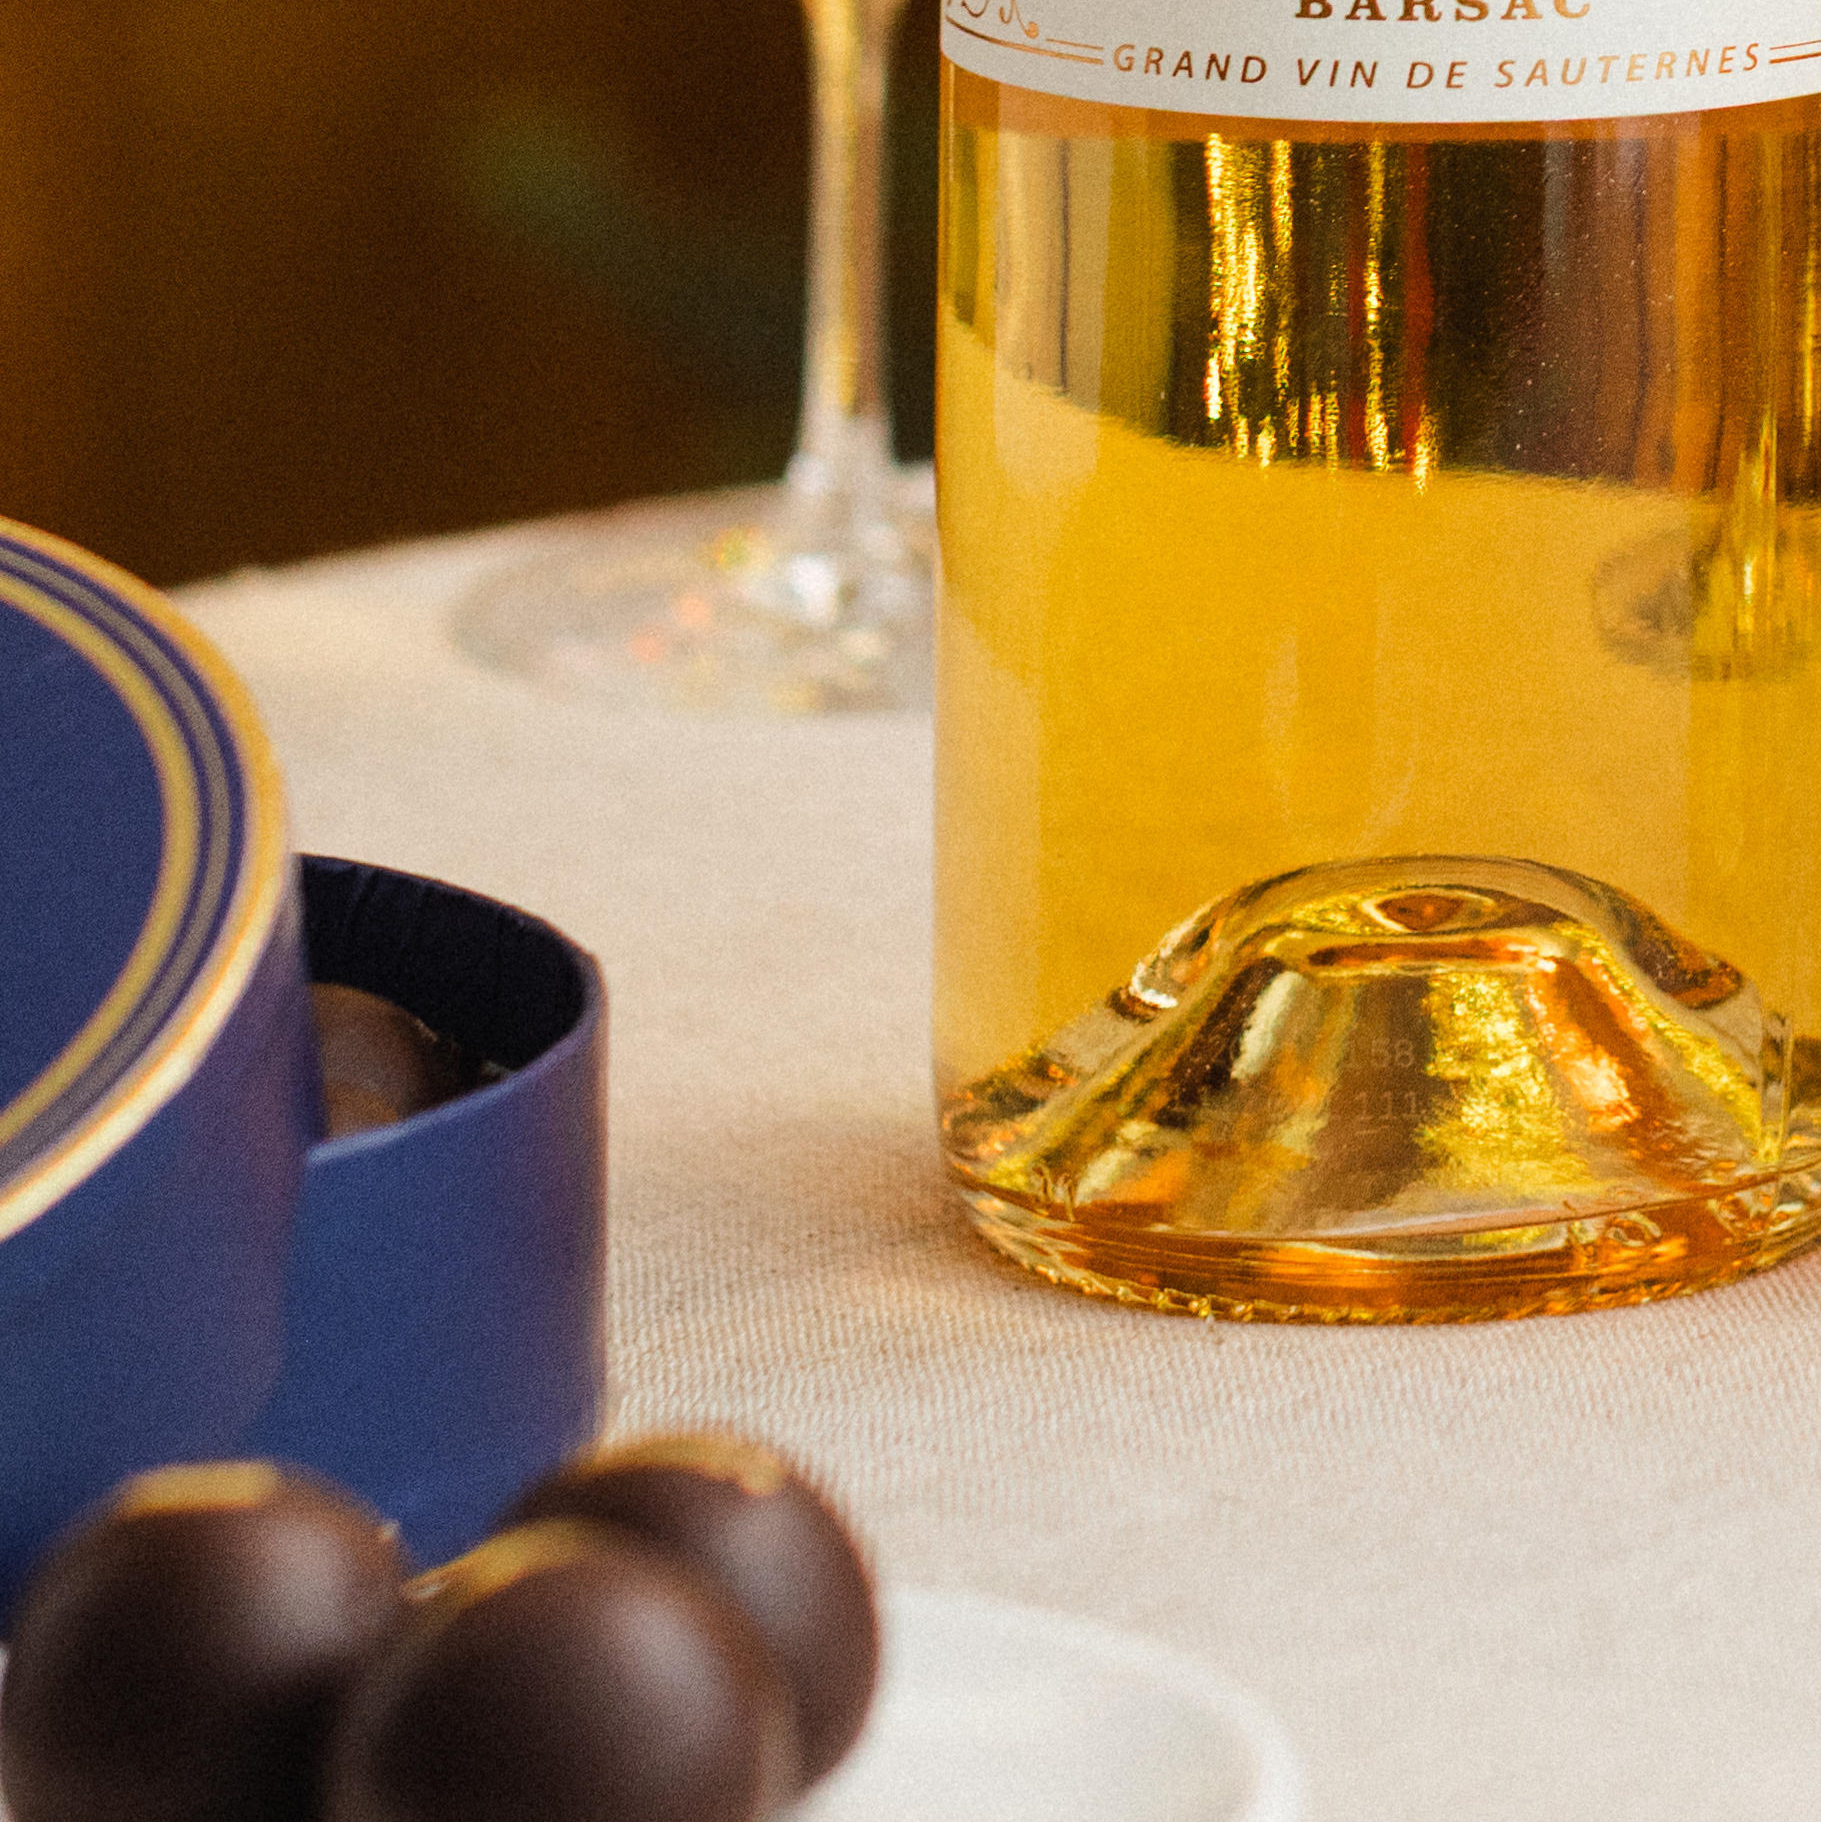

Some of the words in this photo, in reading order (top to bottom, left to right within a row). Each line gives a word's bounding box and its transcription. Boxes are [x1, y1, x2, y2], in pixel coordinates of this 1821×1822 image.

[1112, 41, 1270, 84] GRAND
[1295, 56, 1378, 90] VIN
[1405, 60, 1467, 91] DE
[1498, 41, 1762, 90] SAUTERNES
